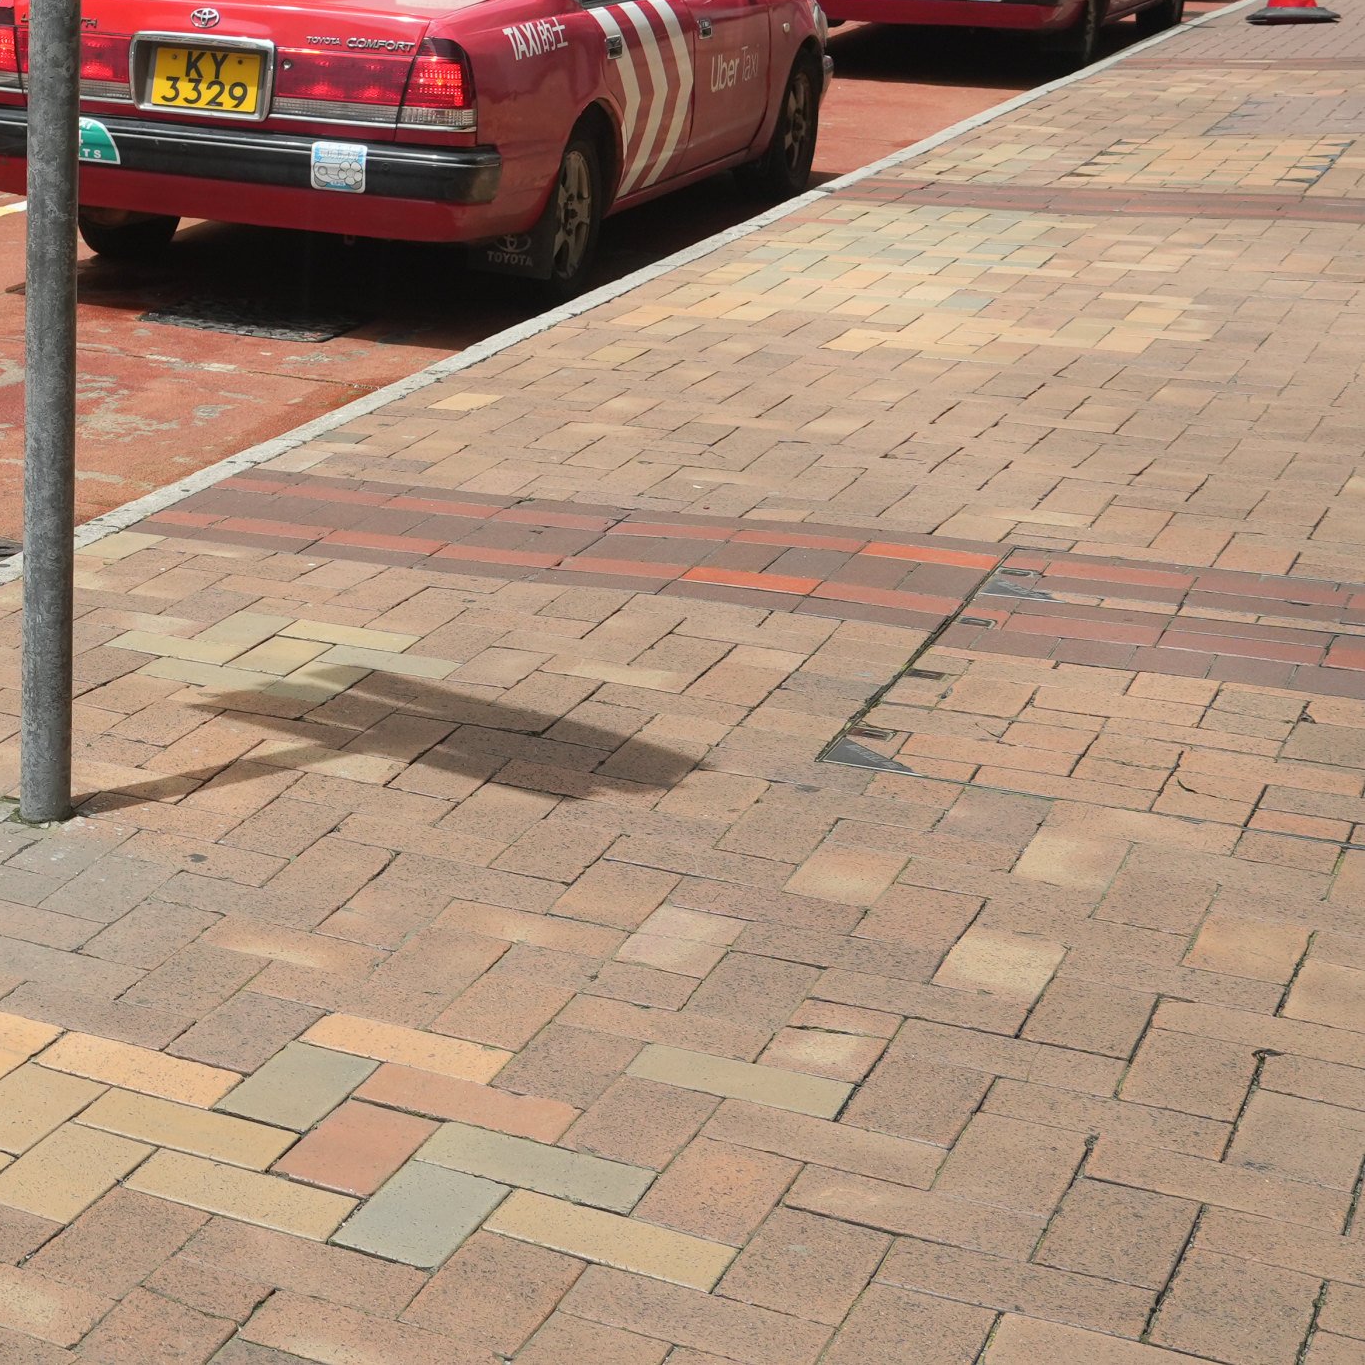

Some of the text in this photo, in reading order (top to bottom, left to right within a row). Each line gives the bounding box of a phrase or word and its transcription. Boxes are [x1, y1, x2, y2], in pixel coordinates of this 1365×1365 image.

[306, 35, 416, 51] TOYOTA COMFORT
[184, 51, 230, 80] KY
[710, 44, 760, 93] Uber Taxi
[161, 75, 248, 109] 3329
[487, 250, 533, 268] TOYOTA
